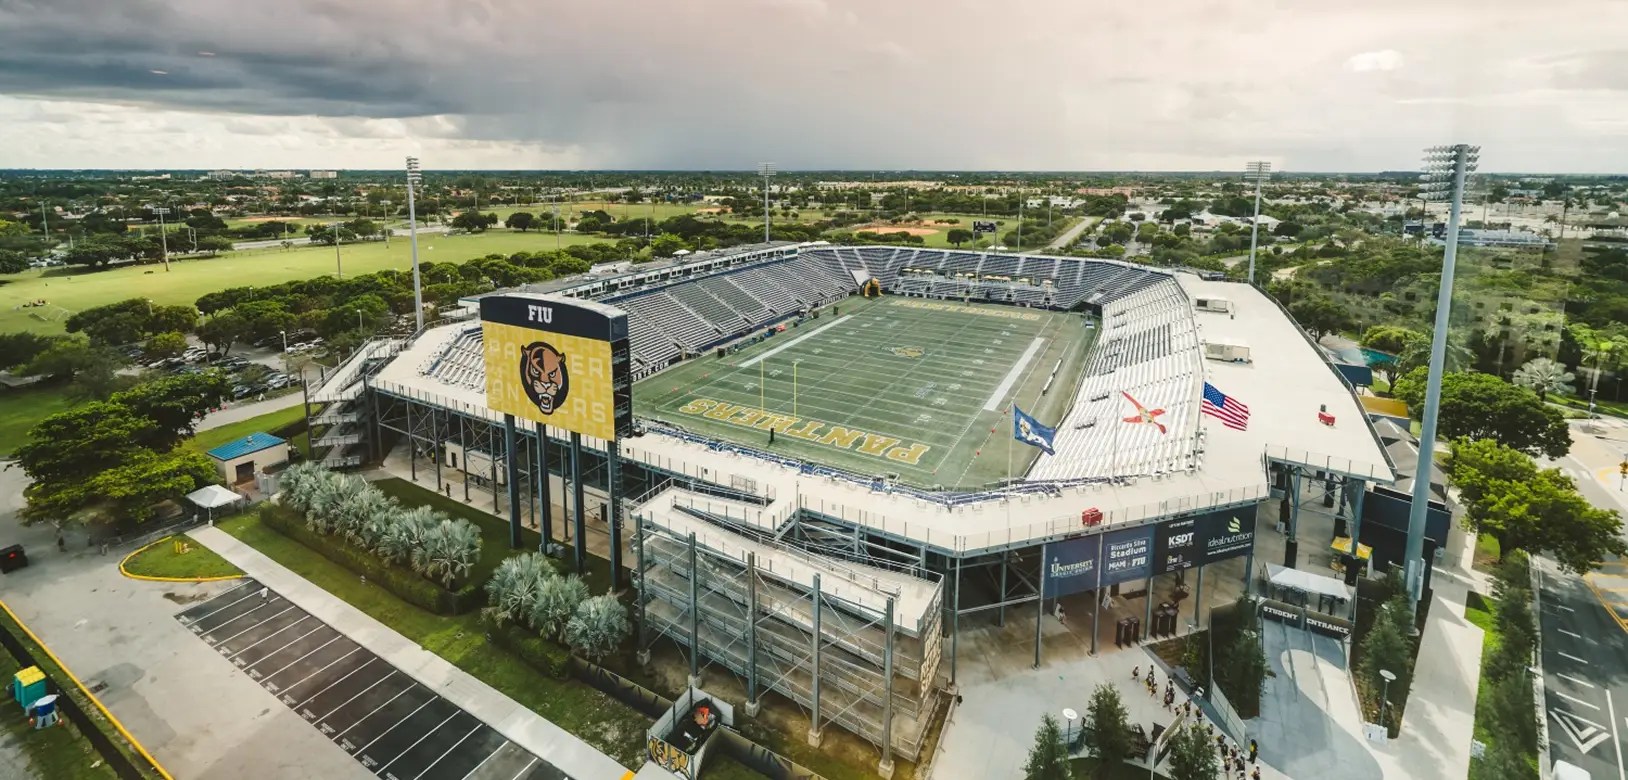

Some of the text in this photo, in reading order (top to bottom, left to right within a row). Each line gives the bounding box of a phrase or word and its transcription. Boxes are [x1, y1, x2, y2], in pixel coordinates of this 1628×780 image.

[528, 304, 553, 324] FIU
[678, 399, 931, 465] PANTHERS
[1168, 532, 1194, 546] KSDT
[1110, 546, 1147, 559] Stadium
[1131, 556, 1146, 568] FIU
[1263, 606, 1350, 634] STUDENT ENTRANCE
